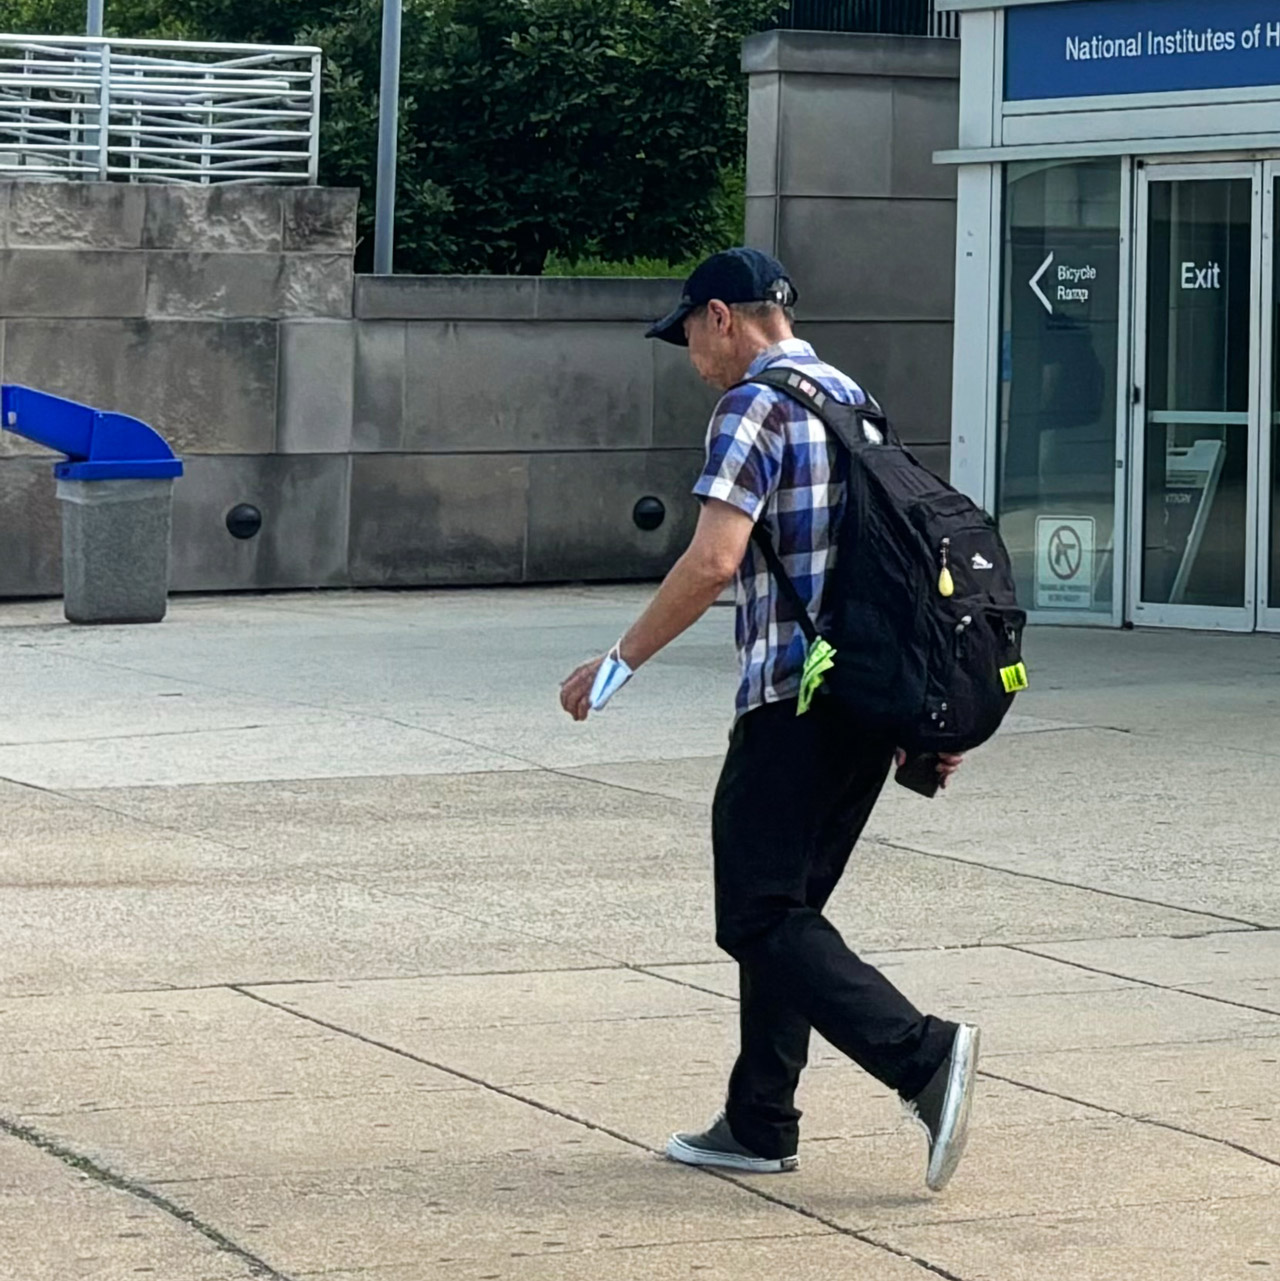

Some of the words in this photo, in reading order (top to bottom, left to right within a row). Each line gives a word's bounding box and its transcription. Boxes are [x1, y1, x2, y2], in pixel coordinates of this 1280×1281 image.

[1065, 32, 1142, 61] National
[1147, 28, 1236, 56] Institutes
[1241, 23, 1261, 48] of
[1057, 265, 1097, 283] Bicycle
[1181, 260, 1221, 289] Exit
[1057, 285, 1089, 303] Ramp
